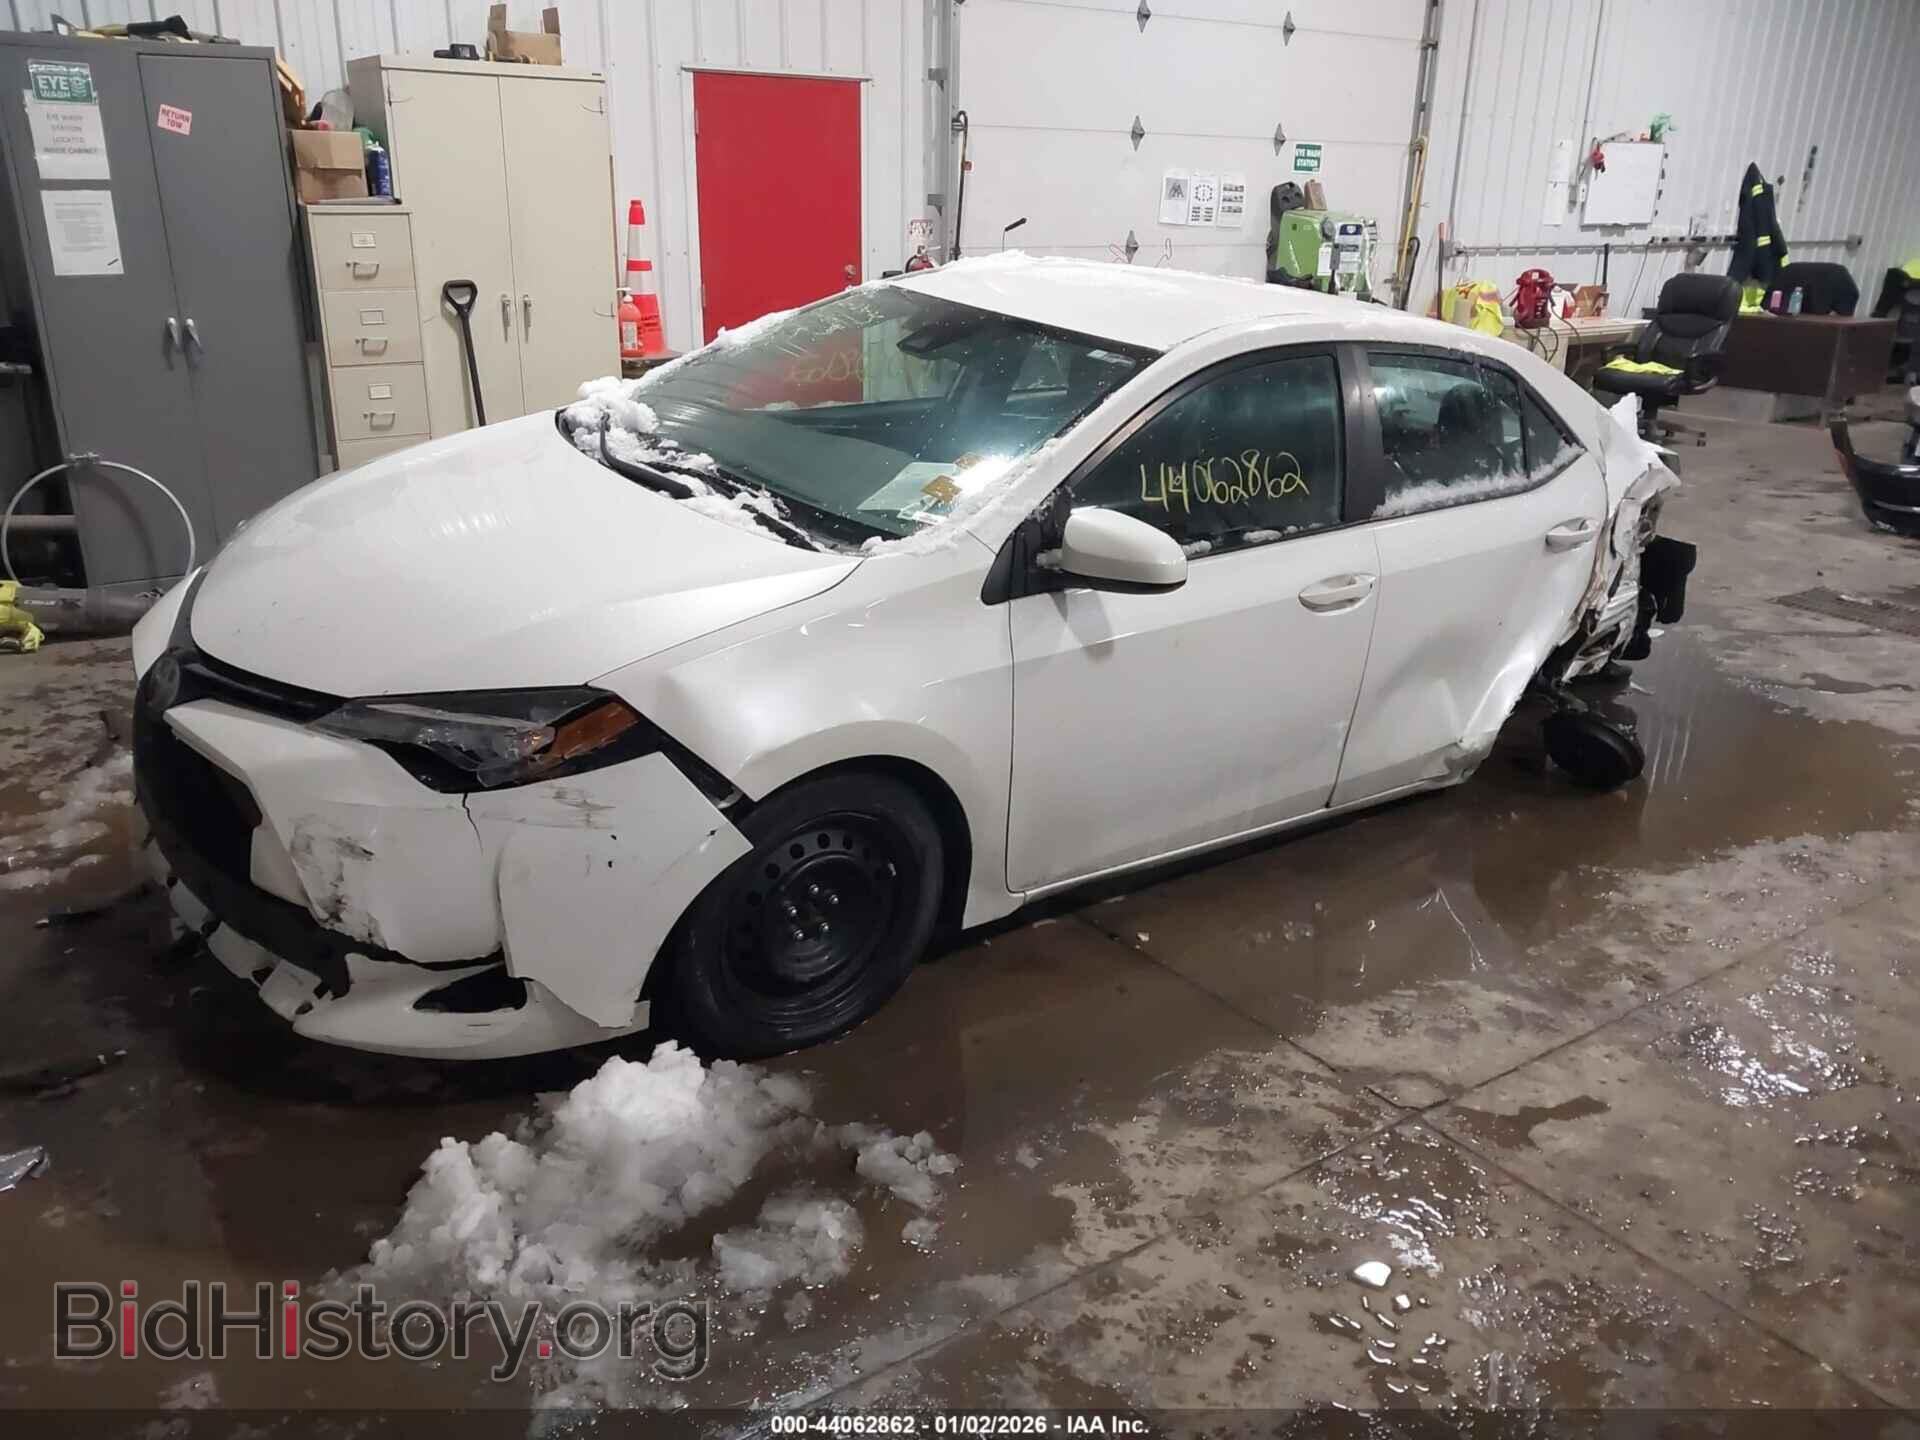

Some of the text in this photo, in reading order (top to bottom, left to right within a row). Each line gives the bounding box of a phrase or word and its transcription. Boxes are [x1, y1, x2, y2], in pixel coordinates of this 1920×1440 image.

[36, 74, 69, 90] EYE
[40, 90, 71, 98] WASH
[167, 118, 185, 129] TOW
[1296, 158, 1318, 167] STATION
[1140, 449, 1310, 513] 44062862
